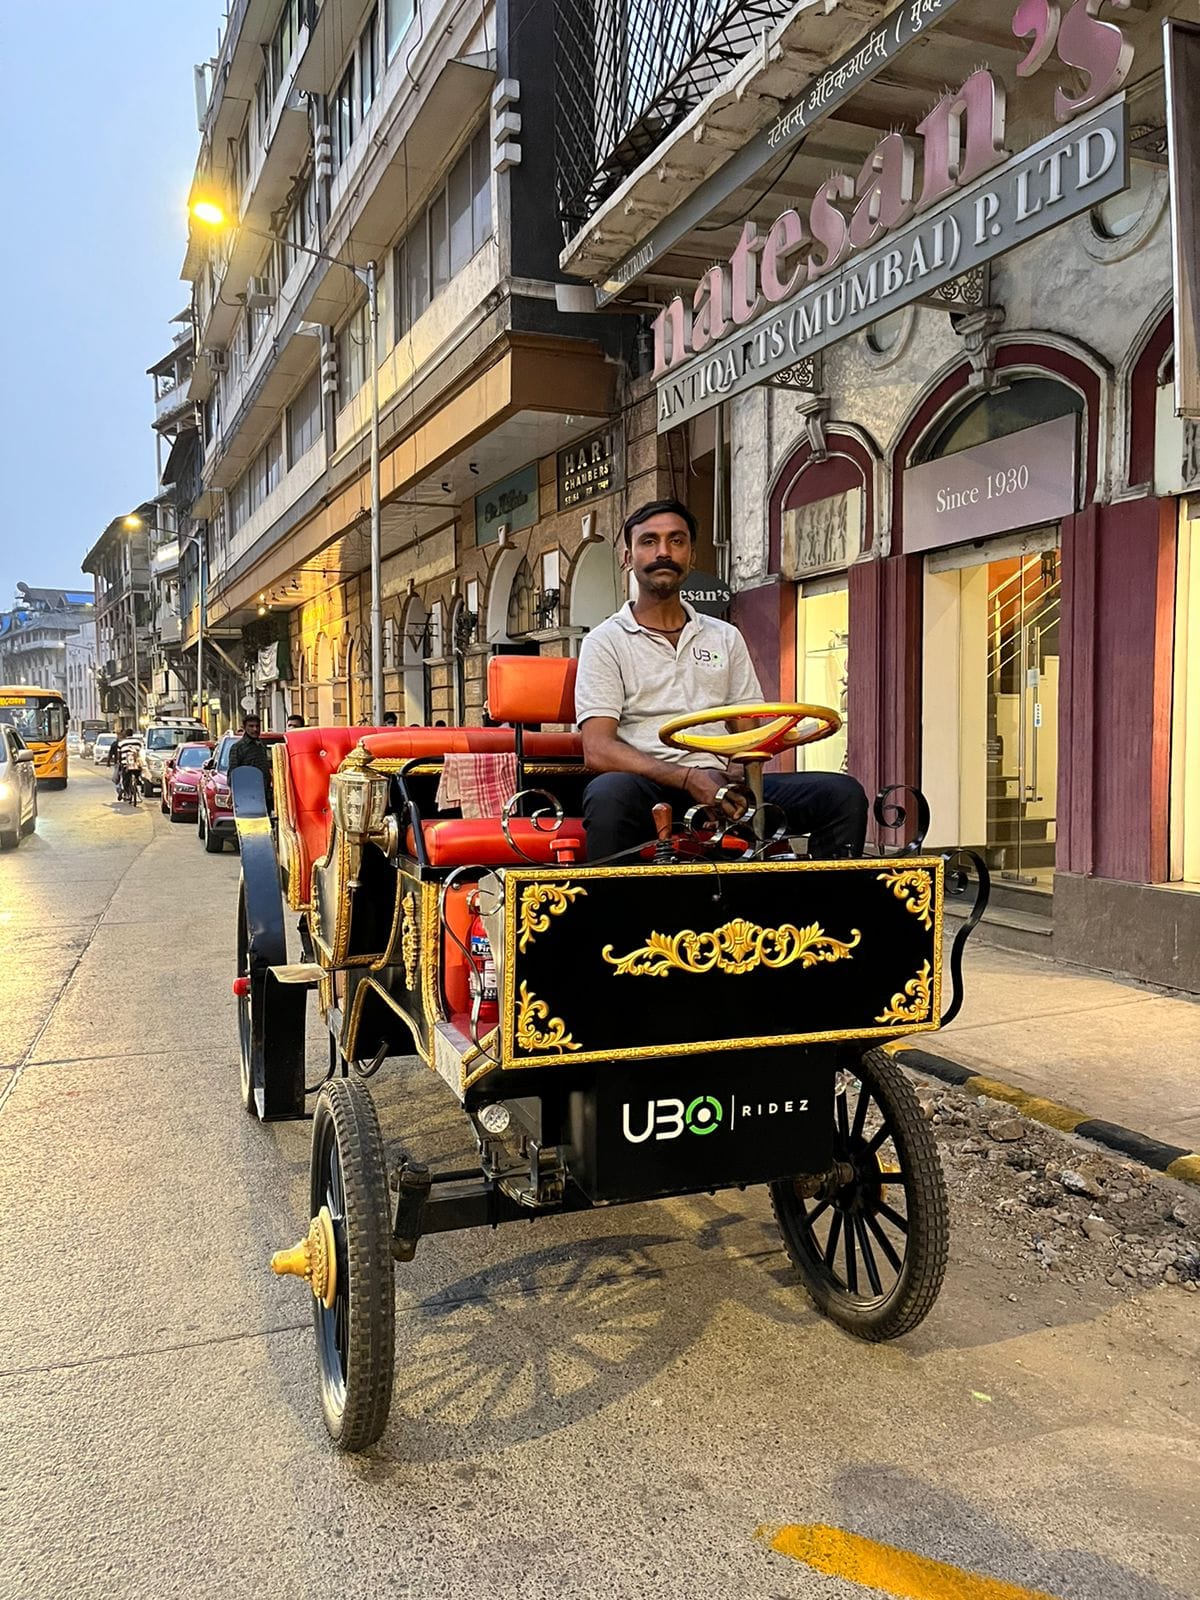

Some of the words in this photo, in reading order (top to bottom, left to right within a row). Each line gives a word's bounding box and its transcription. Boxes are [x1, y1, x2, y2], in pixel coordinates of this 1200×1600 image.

[789, 215, 961, 355] (MUMBAI)
[973, 192, 1002, 246] P.
[1015, 127, 1117, 223] LTD
[564, 435, 612, 476] HARI
[564, 463, 609, 492] CHAMBERS
[936, 487, 980, 513] Since
[986, 464, 1029, 500] 1930
[679, 588, 731, 602] esan's
[742, 1100, 809, 1117] RIDEZ
